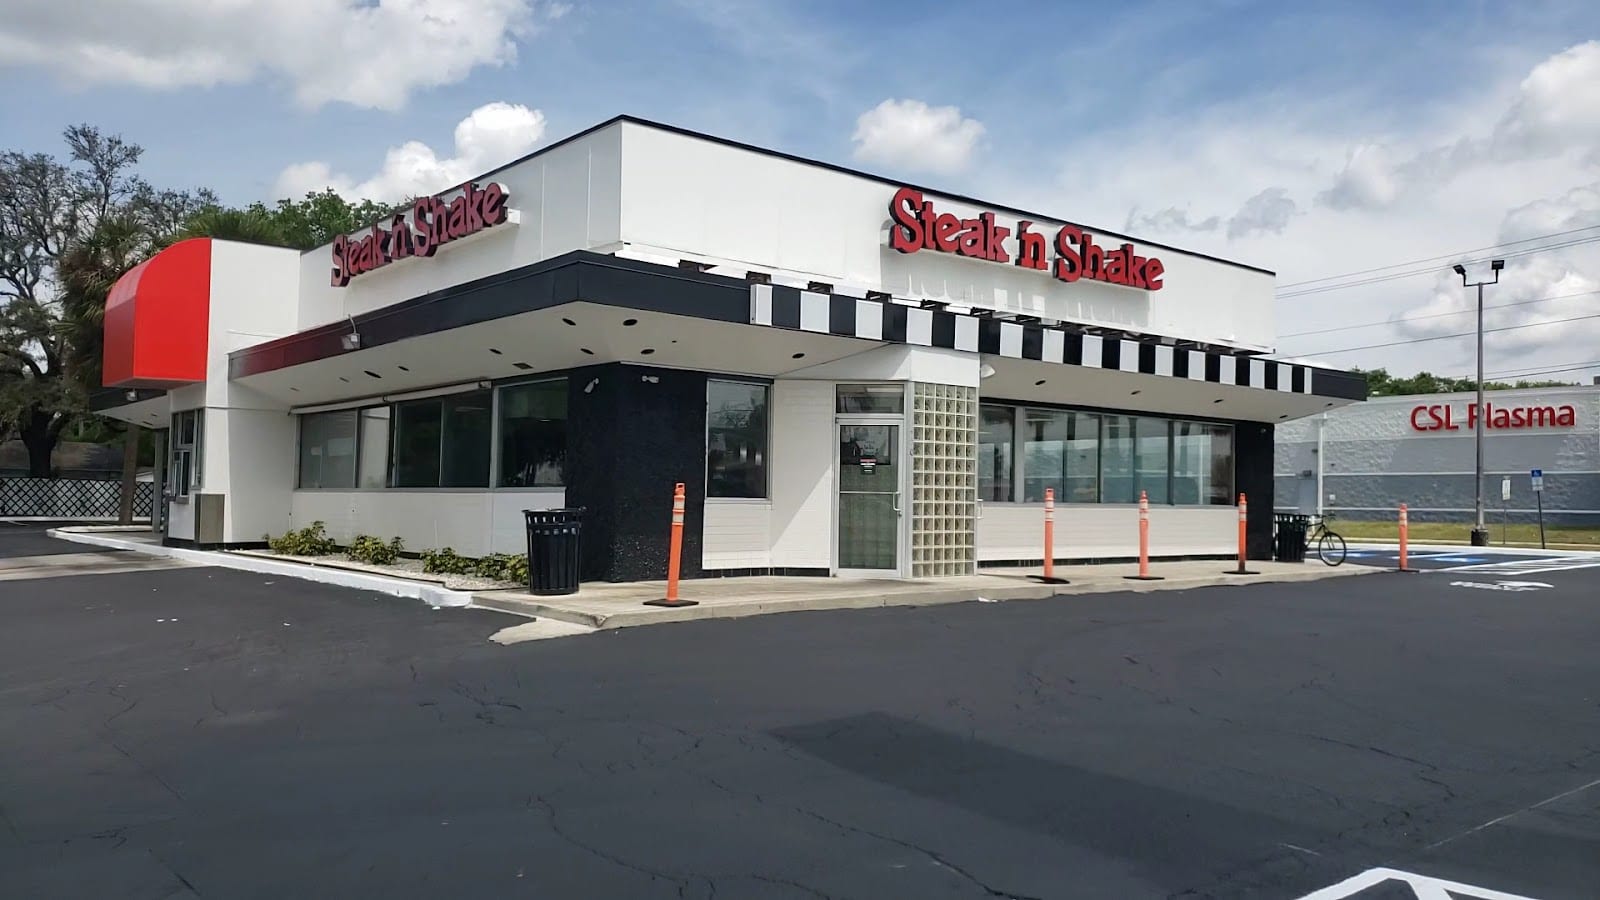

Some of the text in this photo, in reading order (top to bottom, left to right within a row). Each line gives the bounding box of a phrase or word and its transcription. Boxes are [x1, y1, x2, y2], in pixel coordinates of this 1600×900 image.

[331, 222, 386, 287] Steak
[414, 182, 507, 257] Shake
[889, 187, 1010, 263] Steak
[1054, 223, 1165, 290] Shake
[1410, 402, 1576, 431] CSL Plasma
